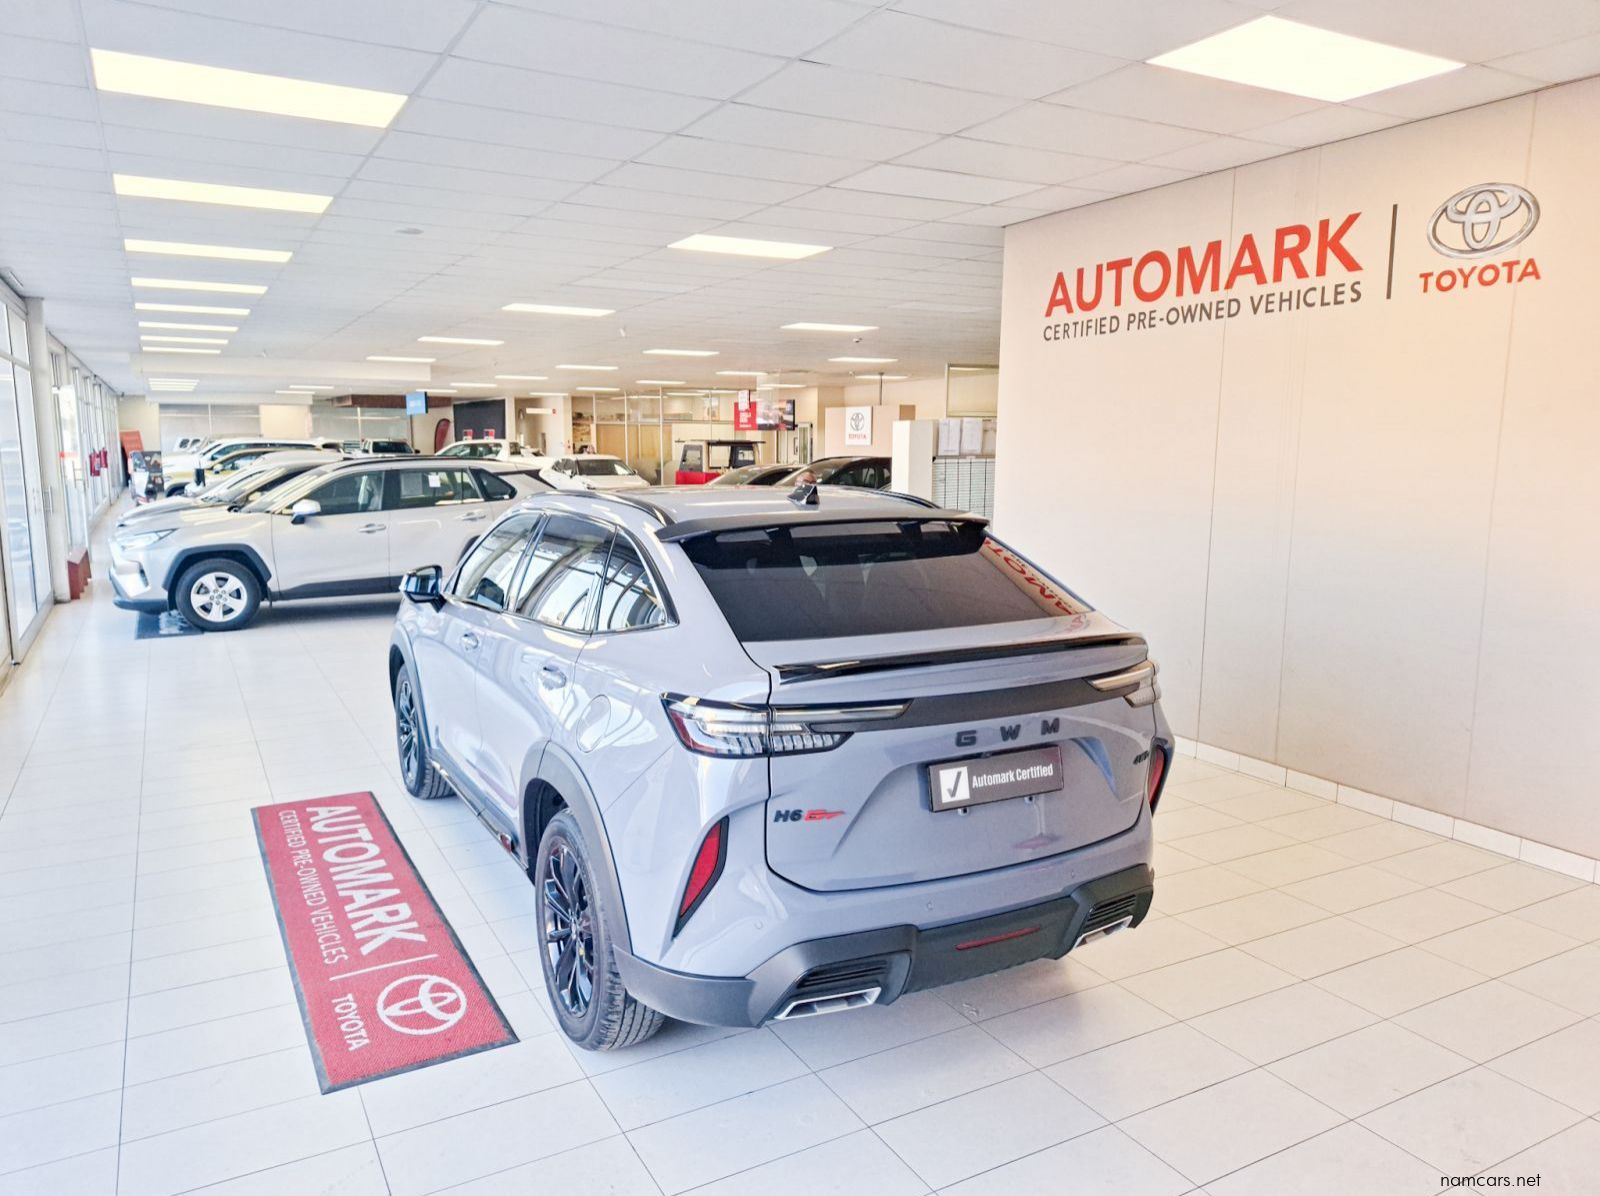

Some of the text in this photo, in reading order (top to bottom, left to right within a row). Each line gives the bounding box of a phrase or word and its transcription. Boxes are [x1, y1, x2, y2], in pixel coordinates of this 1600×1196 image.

[1044, 211, 1363, 318] AUTOMARK
[1418, 257, 1541, 293] TOYOTA
[1043, 281, 1362, 342] CERTIFIED PRE-OWNED VEHICLES
[972, 763, 1054, 789] Automark Certified
[774, 809, 803, 823] H6
[278, 810, 349, 965] CERTIFIED PRE-OWNED VEHICLES
[306, 805, 428, 956] AUTOMARK
[331, 993, 371, 1052] TOYOTA
